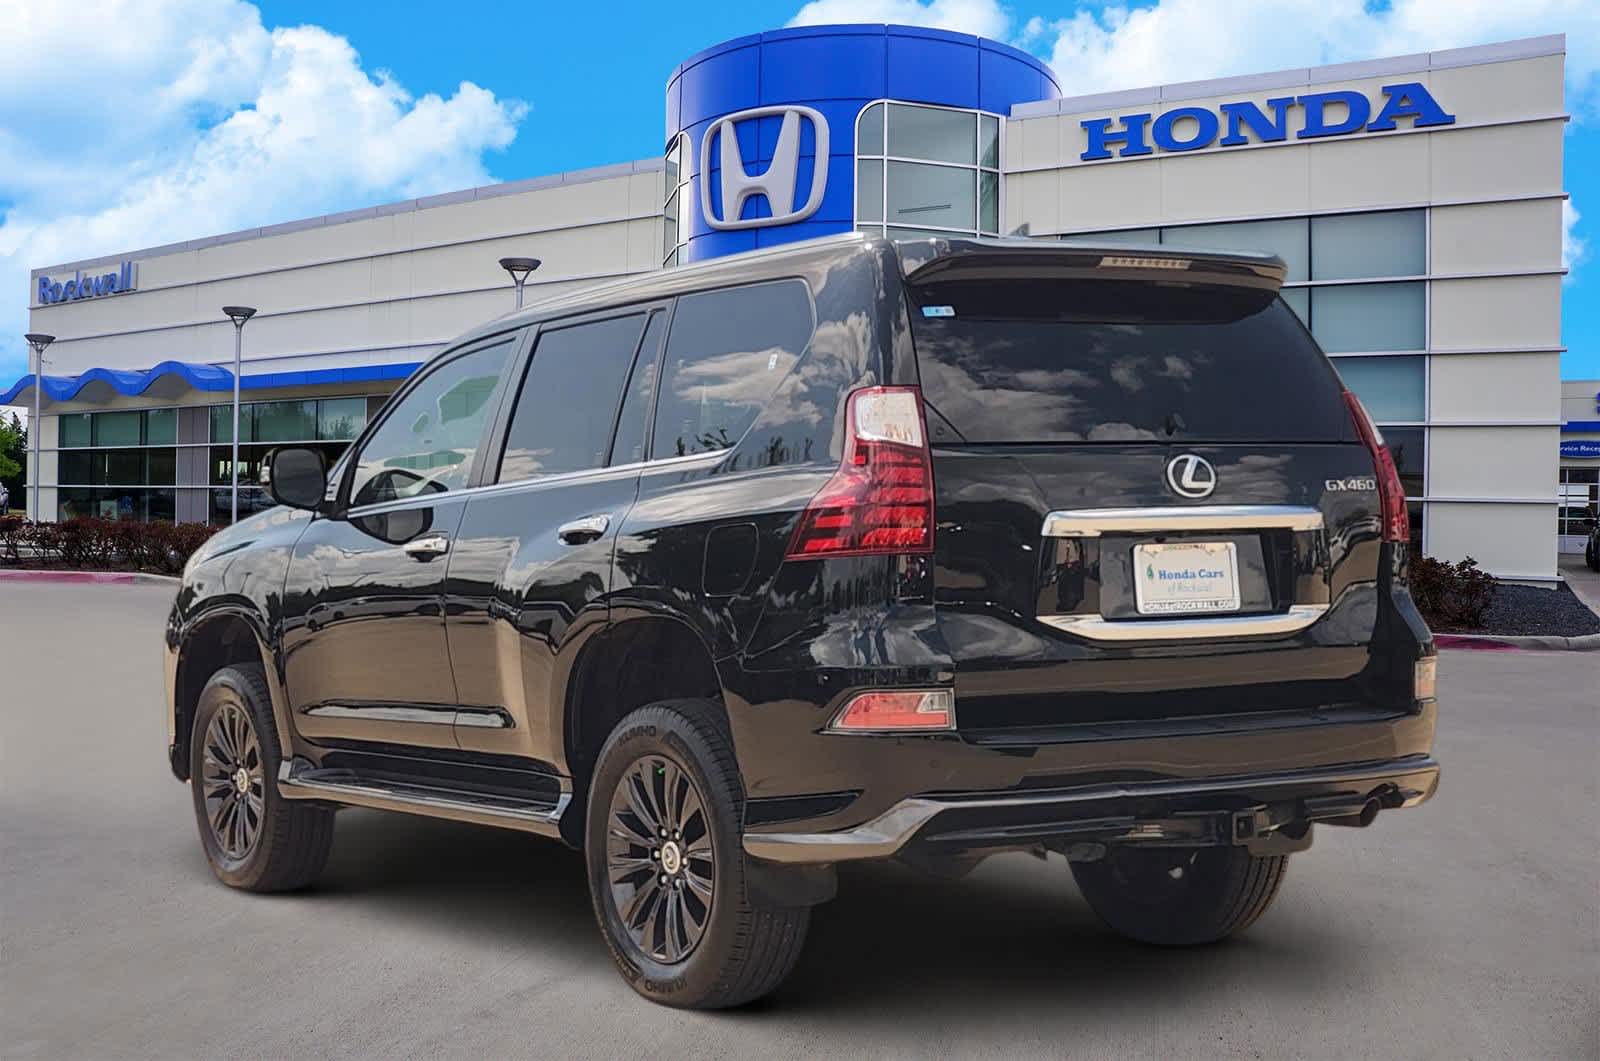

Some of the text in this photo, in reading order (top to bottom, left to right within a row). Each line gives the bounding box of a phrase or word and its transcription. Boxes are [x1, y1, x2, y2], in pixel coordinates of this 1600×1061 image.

[1080, 82, 1455, 161] HONDA
[38, 261, 133, 304] Rockwall
[1158, 568, 1224, 580] Honda Cars
[617, 725, 657, 746] KUMHO
